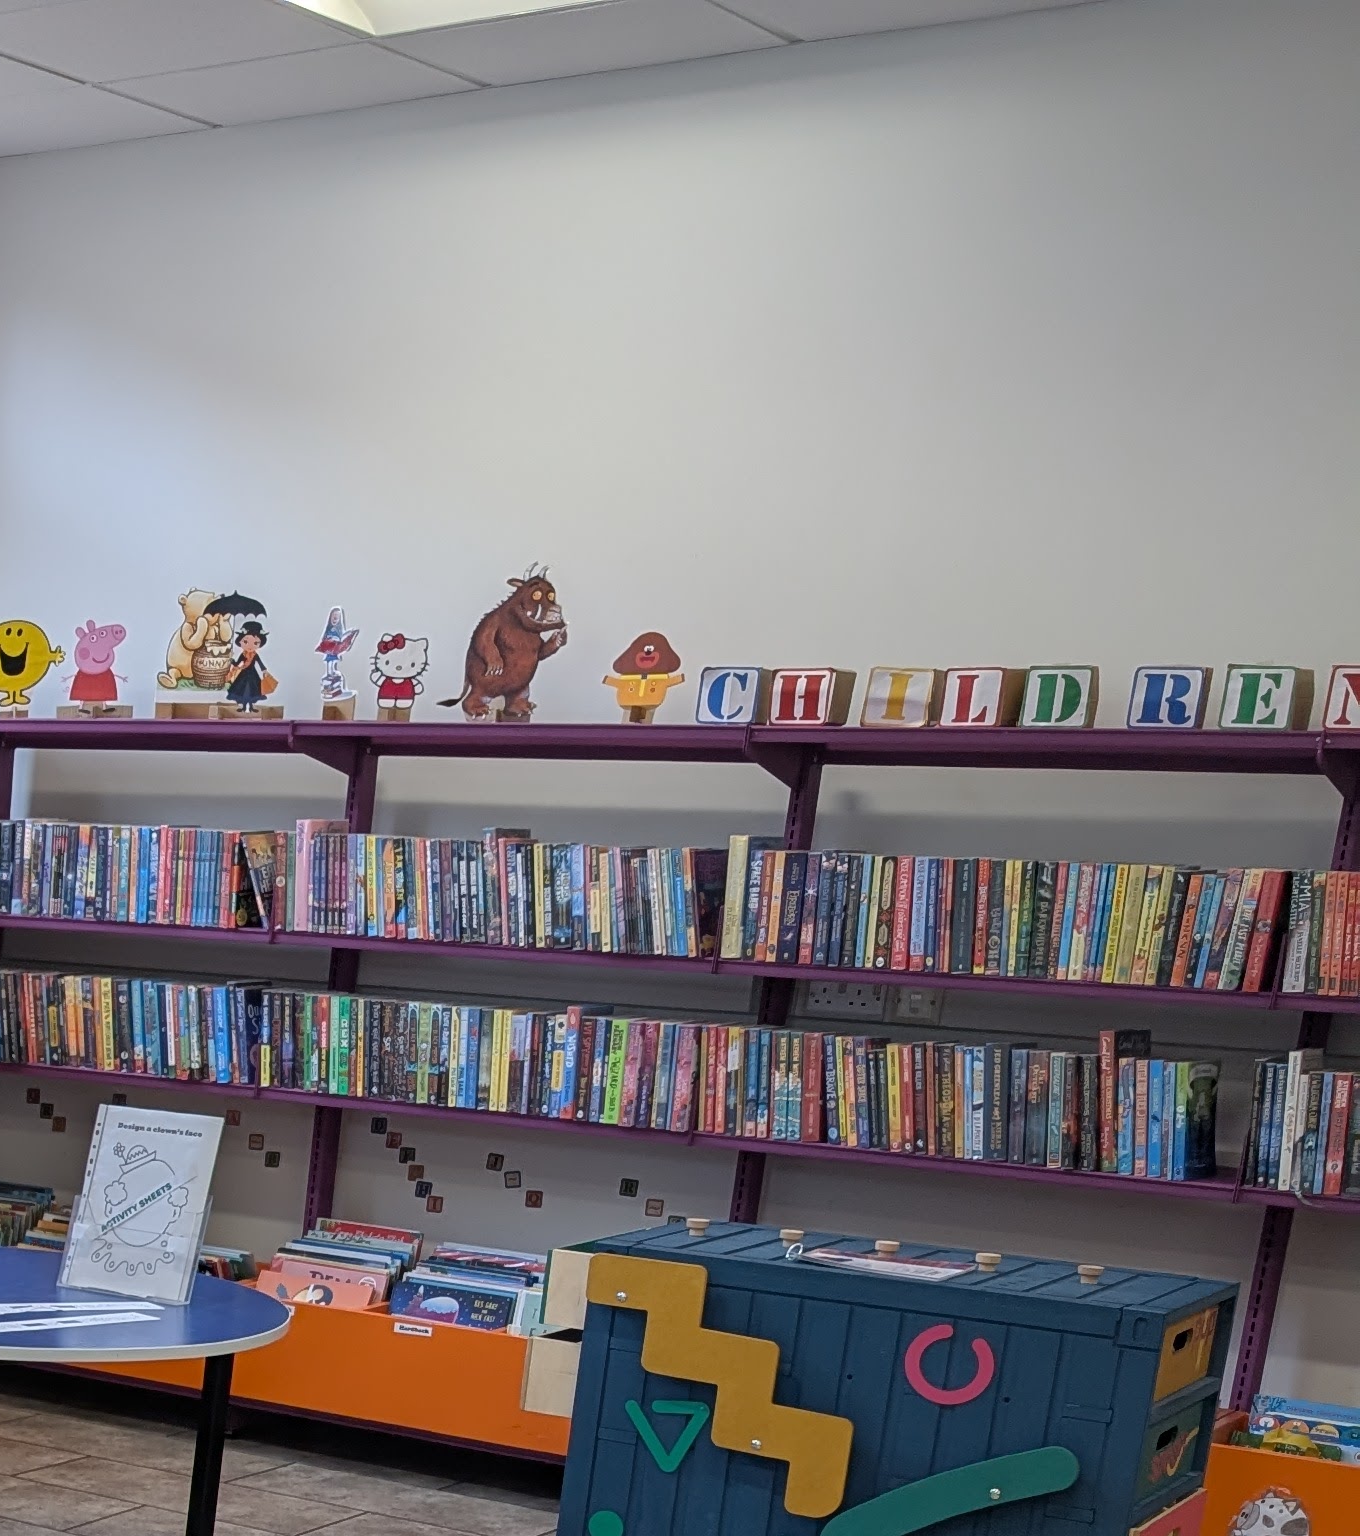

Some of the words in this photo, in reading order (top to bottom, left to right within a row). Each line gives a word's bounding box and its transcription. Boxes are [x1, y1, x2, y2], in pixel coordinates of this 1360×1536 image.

[118, 1122, 144, 1132] Design
[153, 1126, 183, 1135] clown's
[185, 1130, 202, 1138] face
[101, 1203, 138, 1232] ACTIVITY
[139, 1183, 172, 1208] SHEETS
